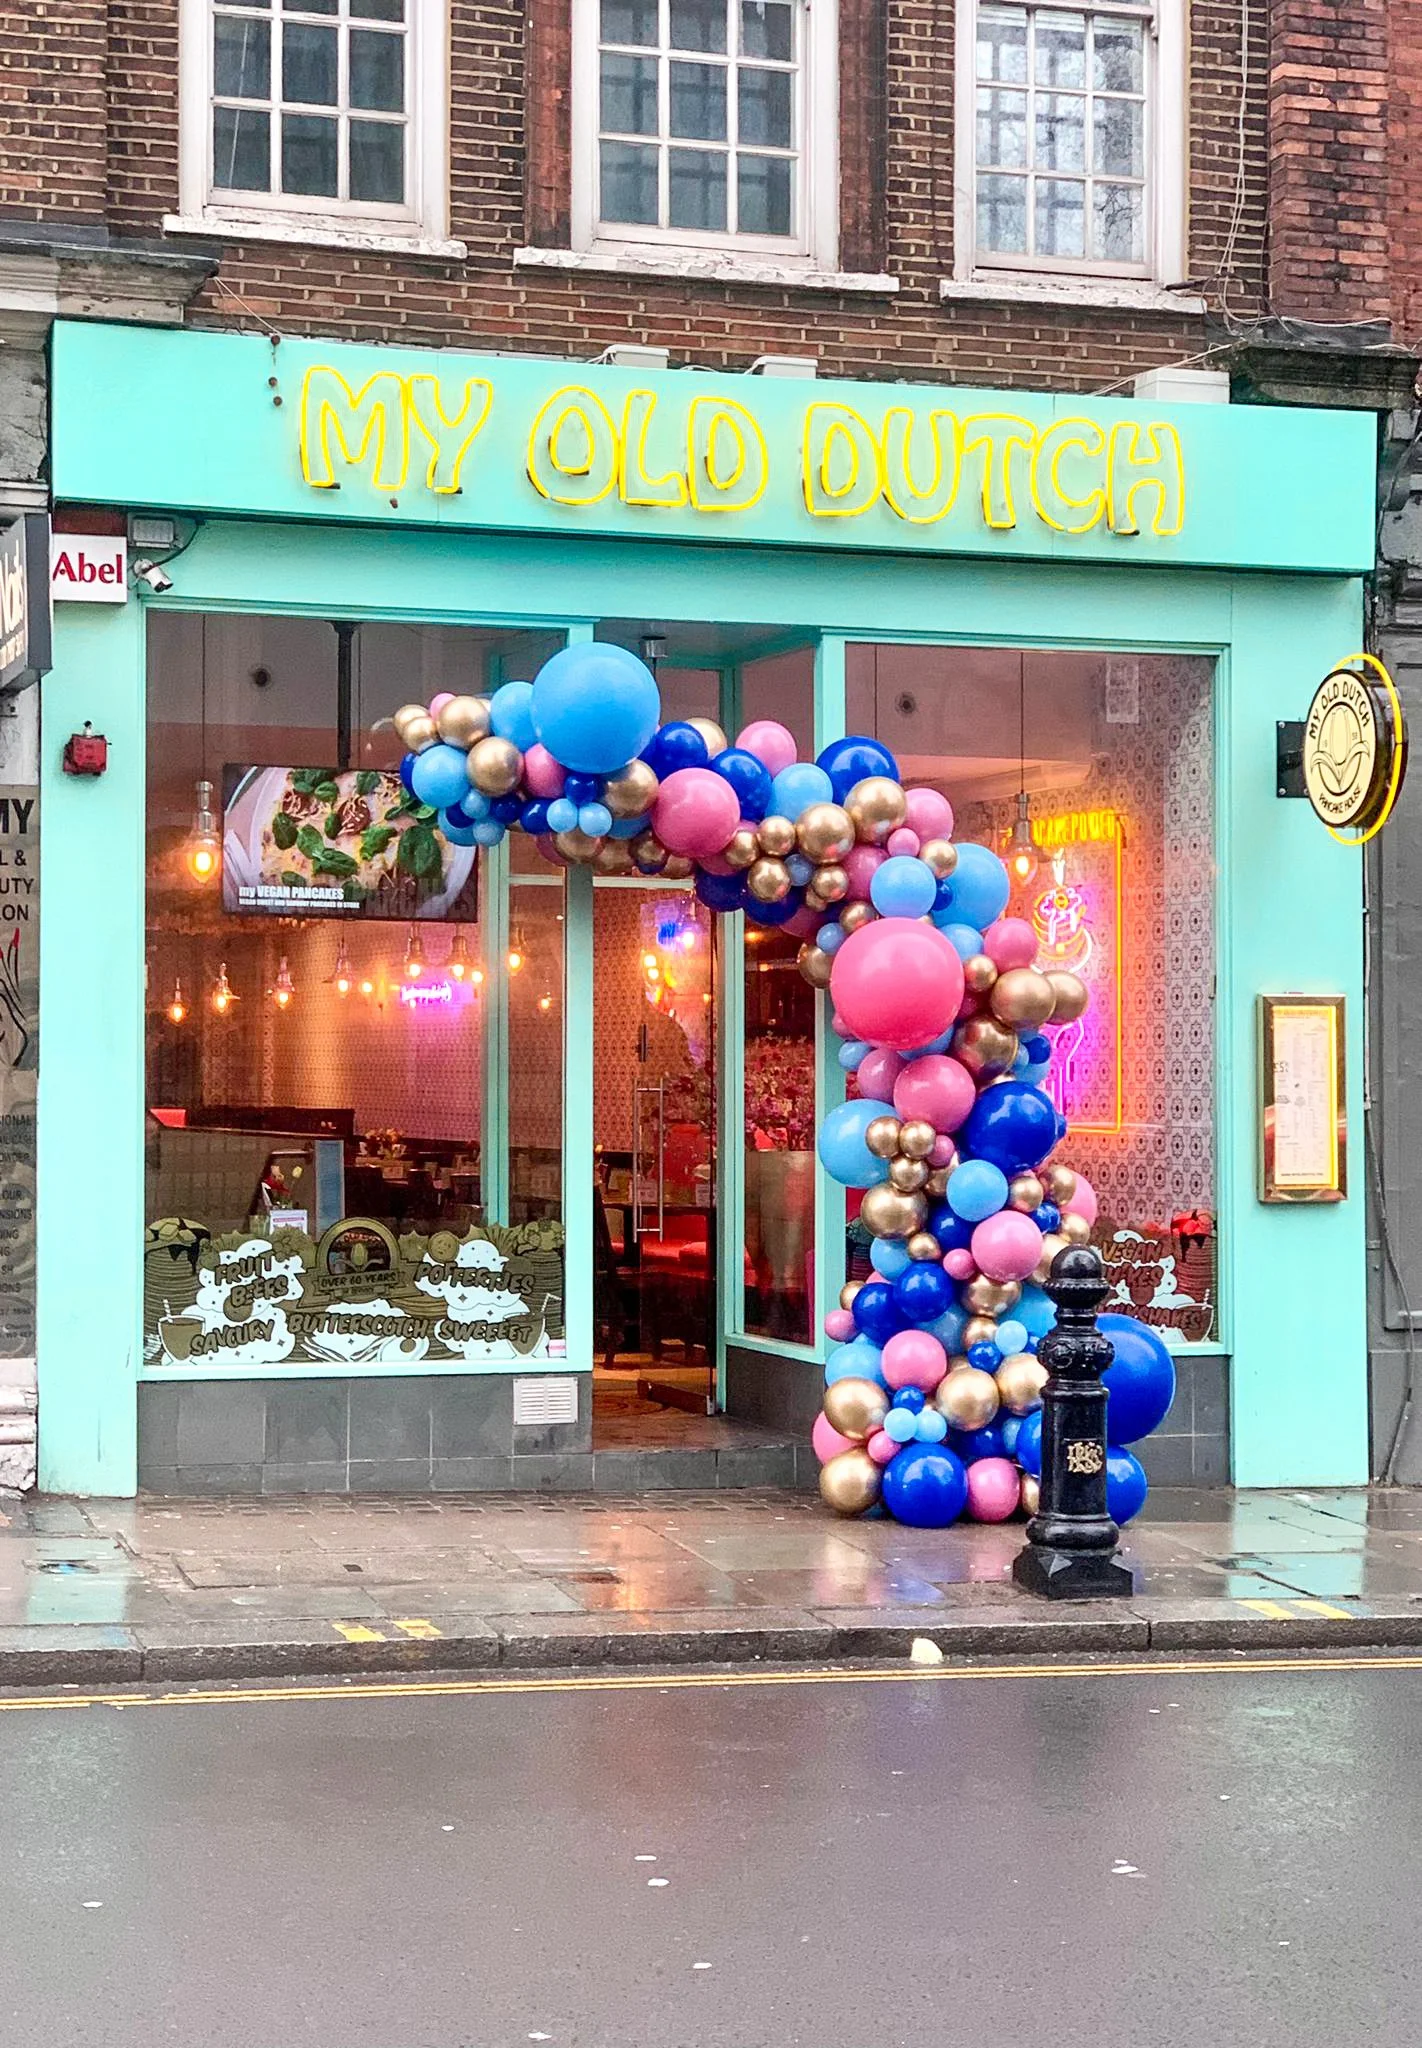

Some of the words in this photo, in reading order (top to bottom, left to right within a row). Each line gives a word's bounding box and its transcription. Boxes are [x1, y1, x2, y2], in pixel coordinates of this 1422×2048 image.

[299, 365, 494, 495] MY
[527, 384, 769, 512] OLD
[802, 401, 1185, 537] DUTCH
[53, 551, 123, 584] Abel
[1309, 708, 1321, 740] MY
[1321, 683, 1339, 710] OLD
[1342, 680, 1371, 728] DUTCH
[256, 885, 290, 898] VEGAN
[292, 887, 345, 900] PANCAKES
[0, 904, 29, 921] ON
[0, 1190, 23, 1201] OUR
[1101, 1238, 1163, 1264] VEGAN
[214, 1249, 275, 1286] FRUIT
[321, 1276, 348, 1288] OVER
[365, 1271, 397, 1284] YEARS
[414, 1261, 536, 1295] POFFERTJES
[230, 1275, 289, 1307] BEERS
[190, 1319, 275, 1356] SAVOURY
[287, 1311, 428, 1339] BUTTERSCOTCH
